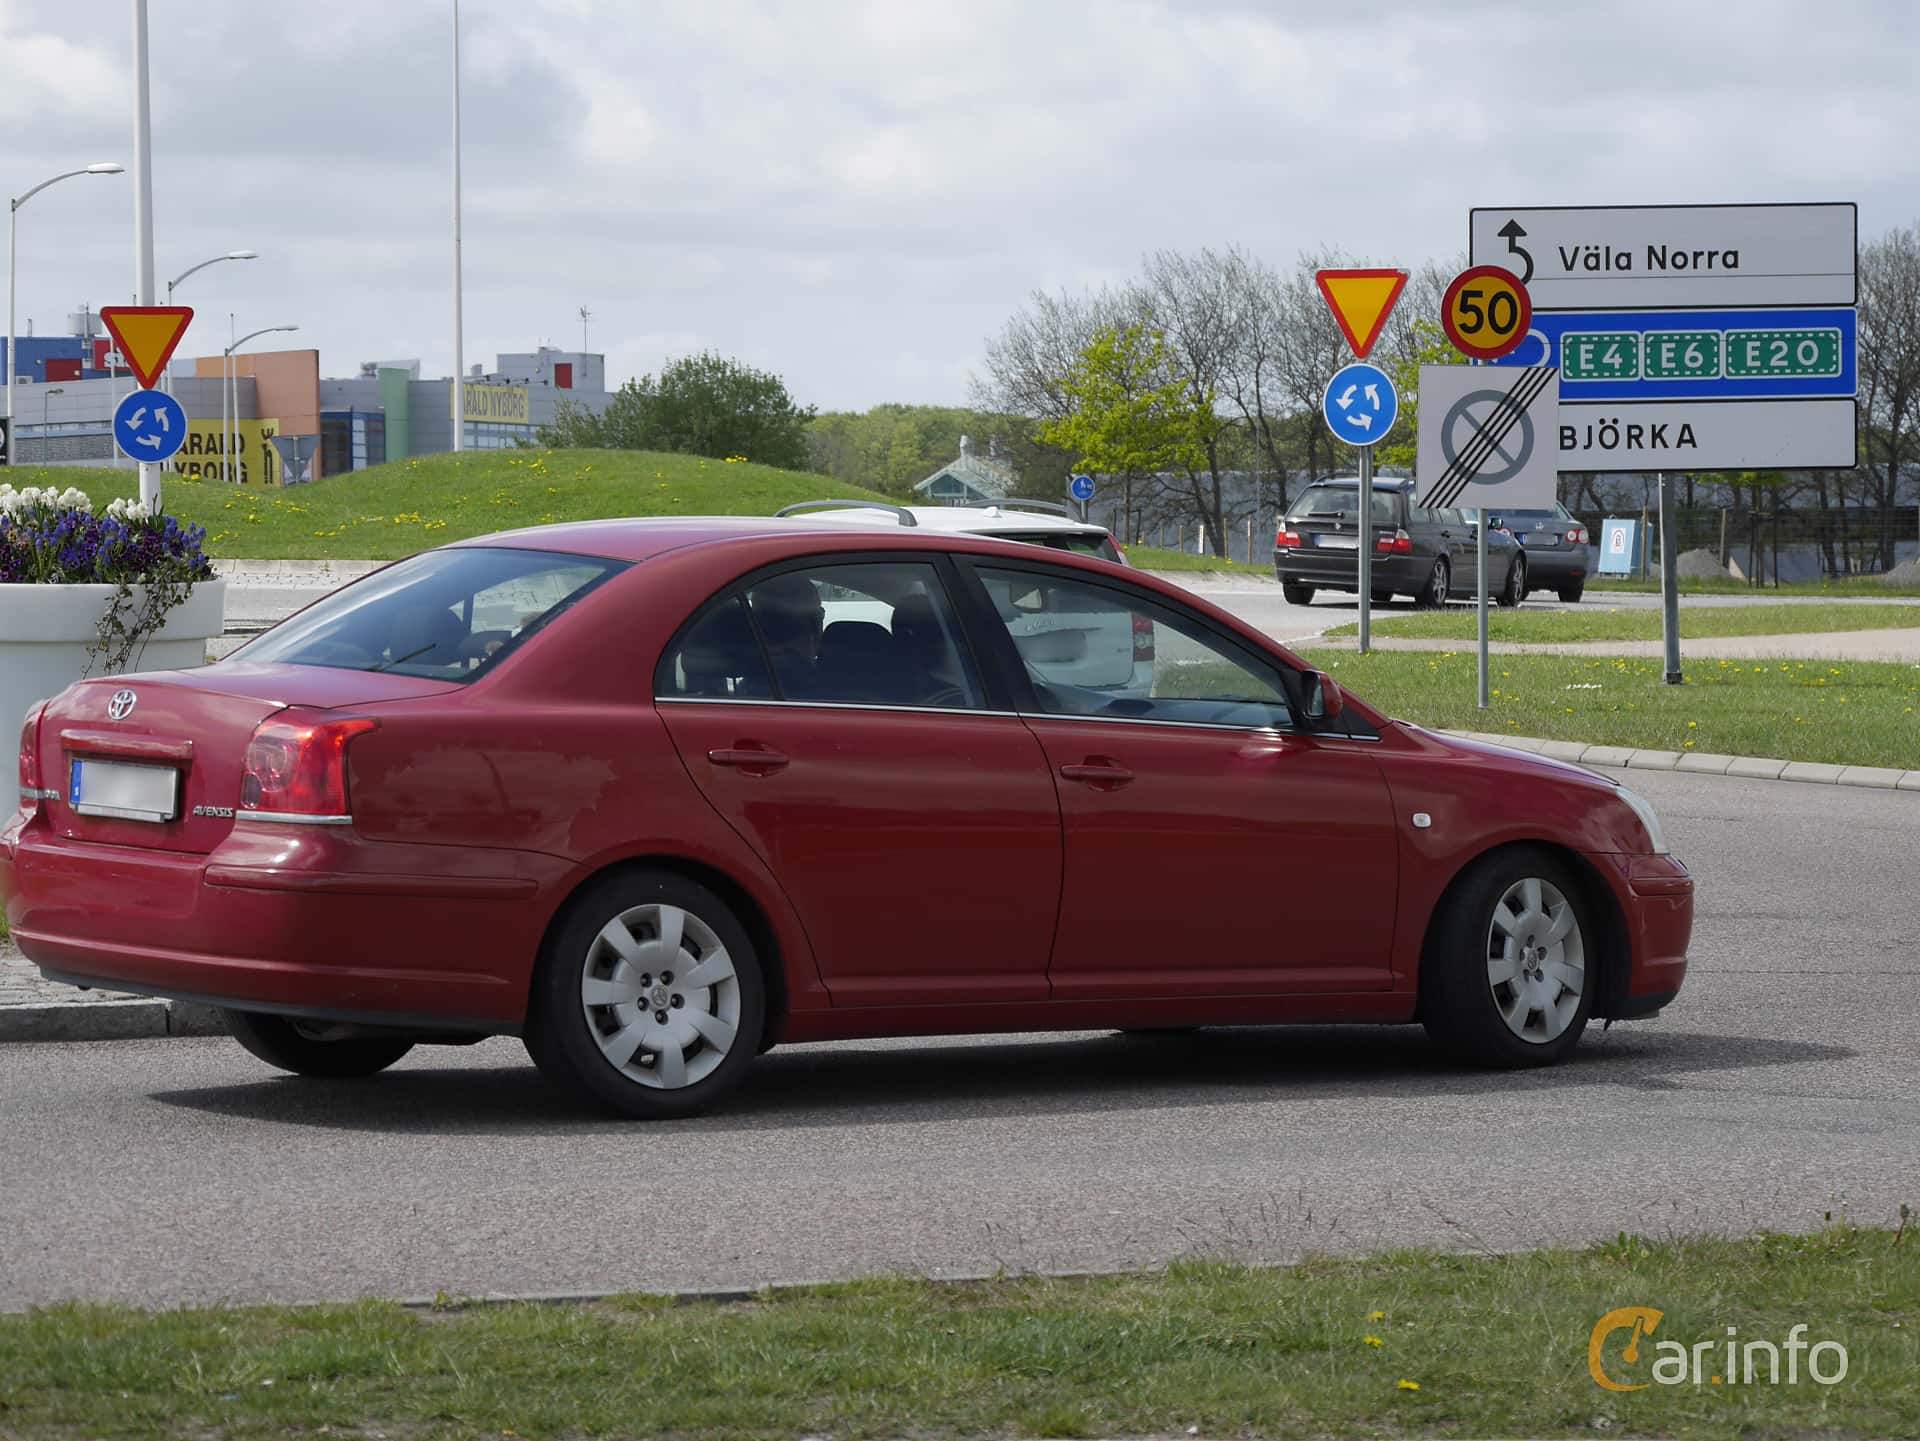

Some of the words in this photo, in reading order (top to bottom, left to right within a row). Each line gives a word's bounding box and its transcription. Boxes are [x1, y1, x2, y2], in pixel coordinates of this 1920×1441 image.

[1559, 245, 1632, 271] Väla
[1647, 245, 1739, 271] Norra
[1458, 289, 1518, 335] 50
[1579, 343, 1623, 370] E4
[1661, 342, 1704, 369] E6
[1746, 340, 1819, 367] E20
[1559, 417, 1698, 451] BJÖRKA
[193, 805, 233, 818] AVENSIS
